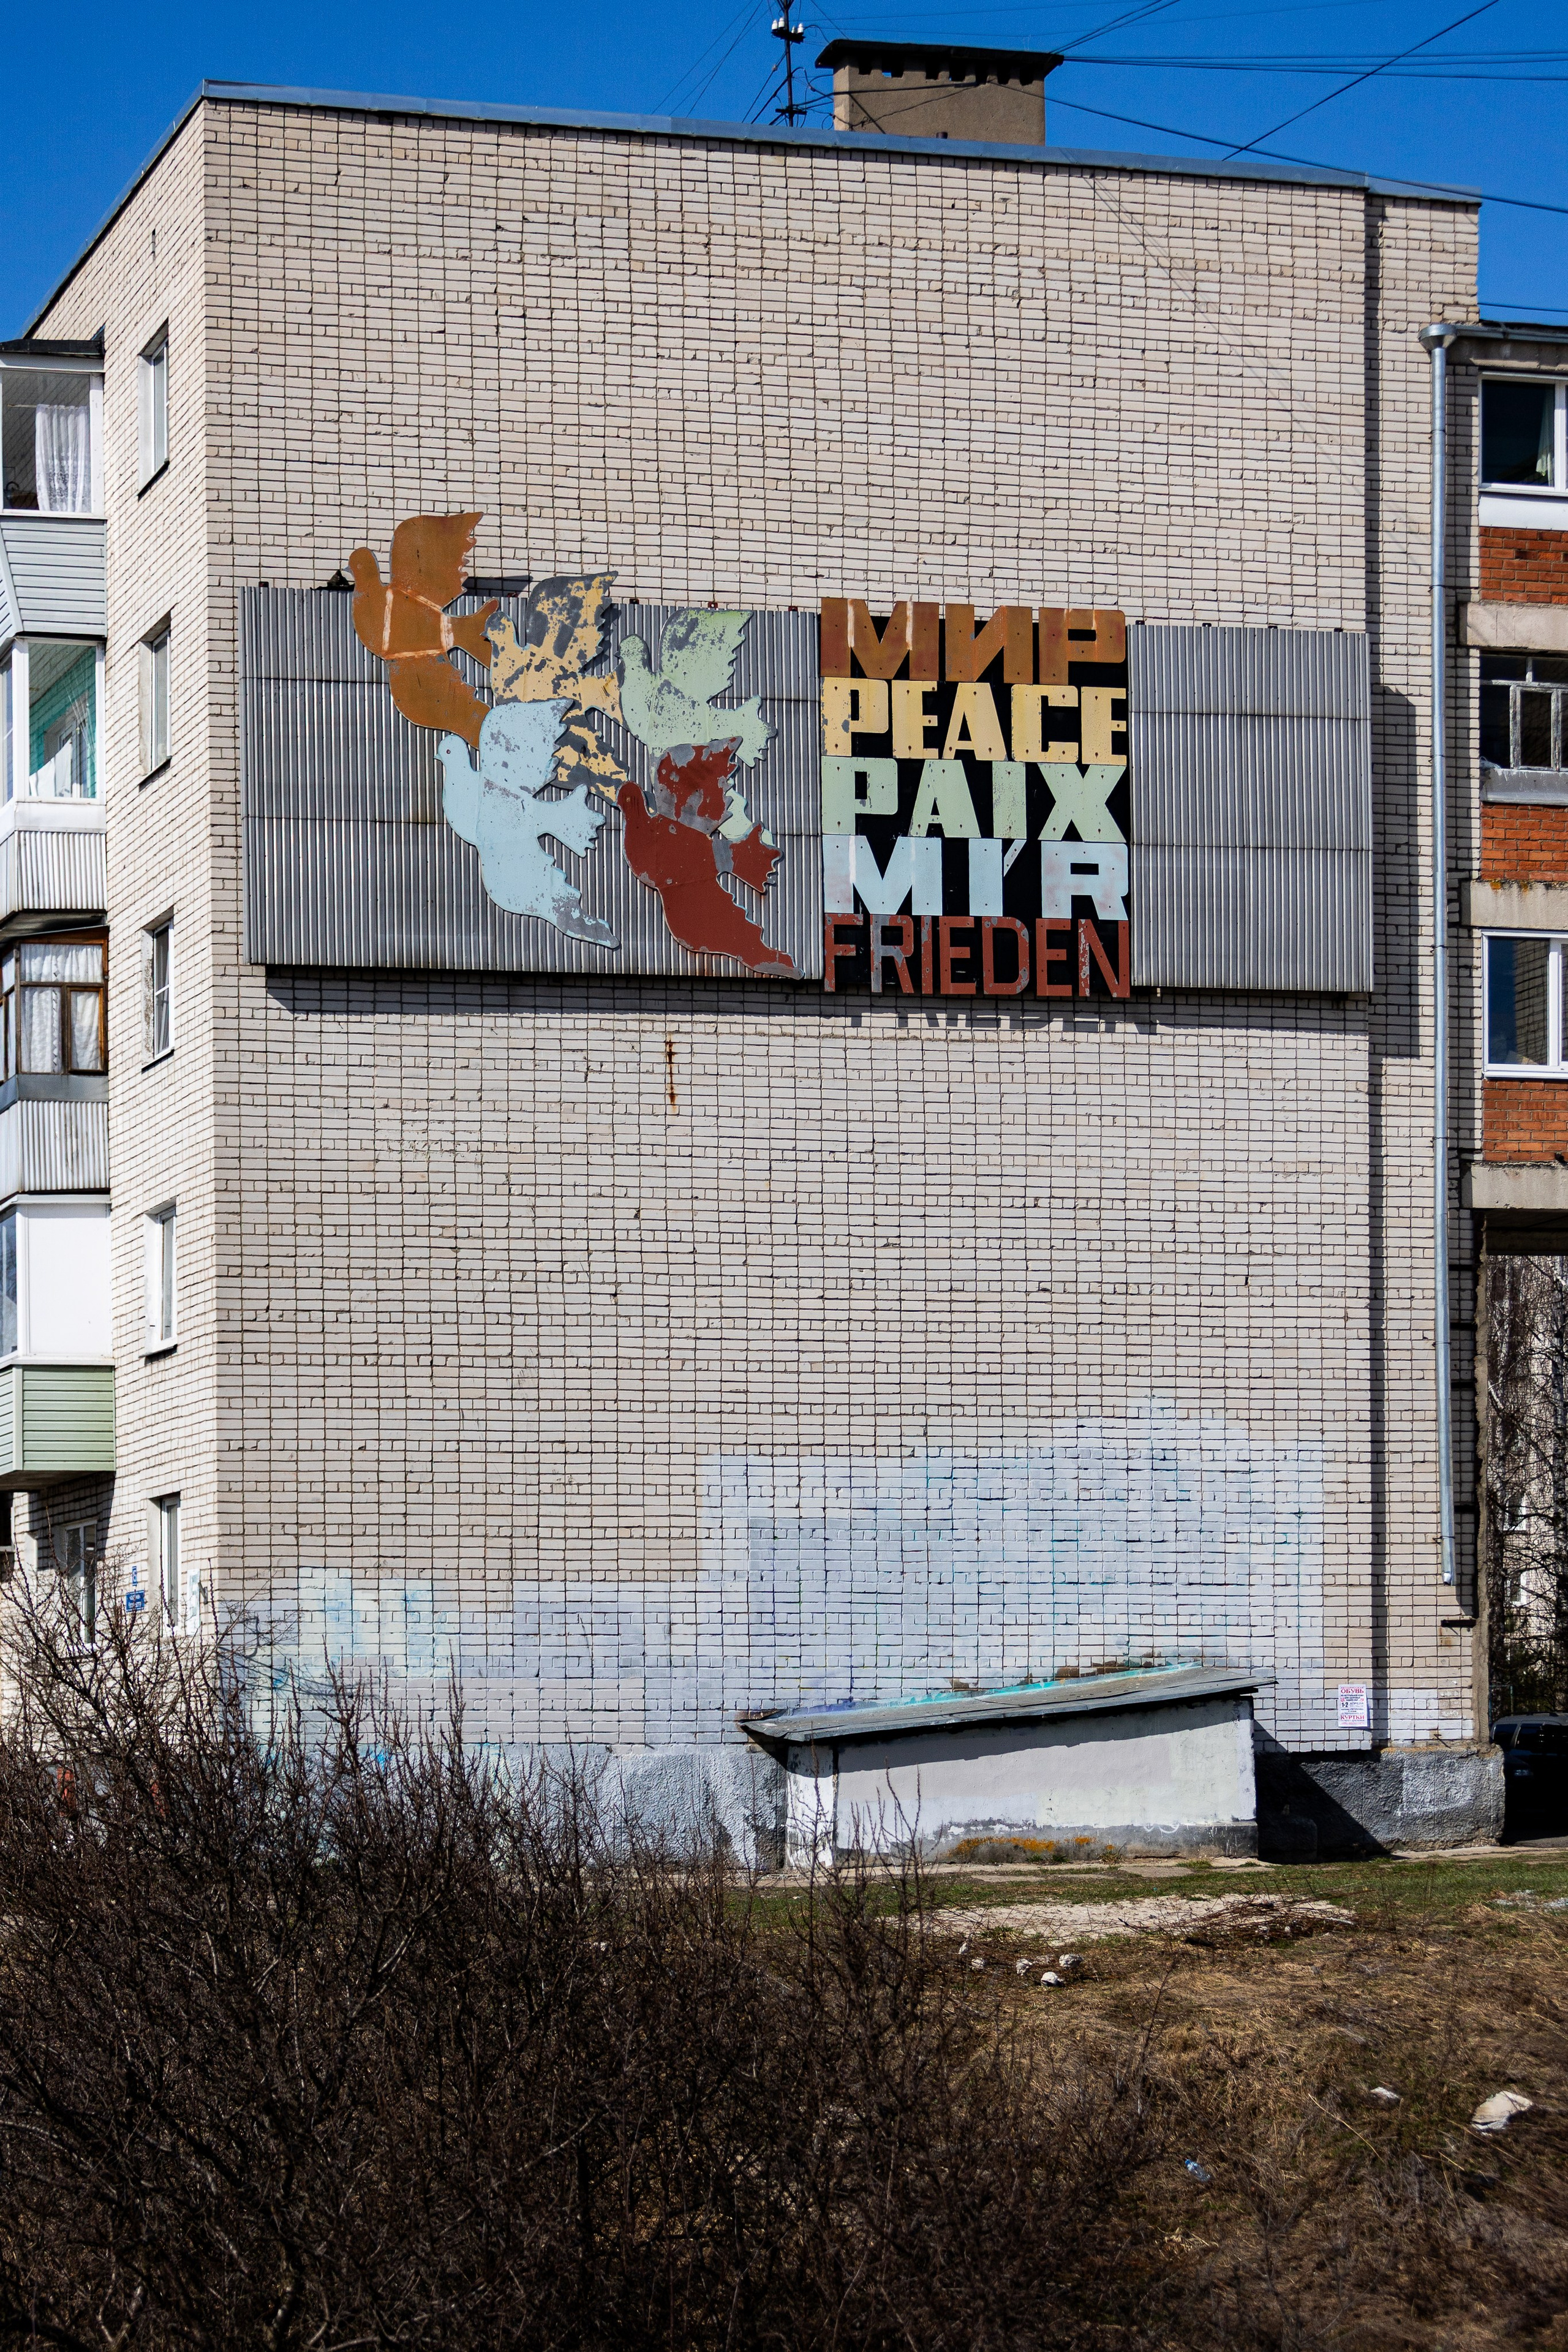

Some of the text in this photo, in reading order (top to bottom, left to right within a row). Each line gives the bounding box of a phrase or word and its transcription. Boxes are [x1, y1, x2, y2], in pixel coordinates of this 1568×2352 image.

[821, 598, 1125, 685] МИР
[821, 677, 1126, 765] PEACE
[821, 756, 1126, 843] PAIX
[824, 913, 1130, 998] FRIEDEN
